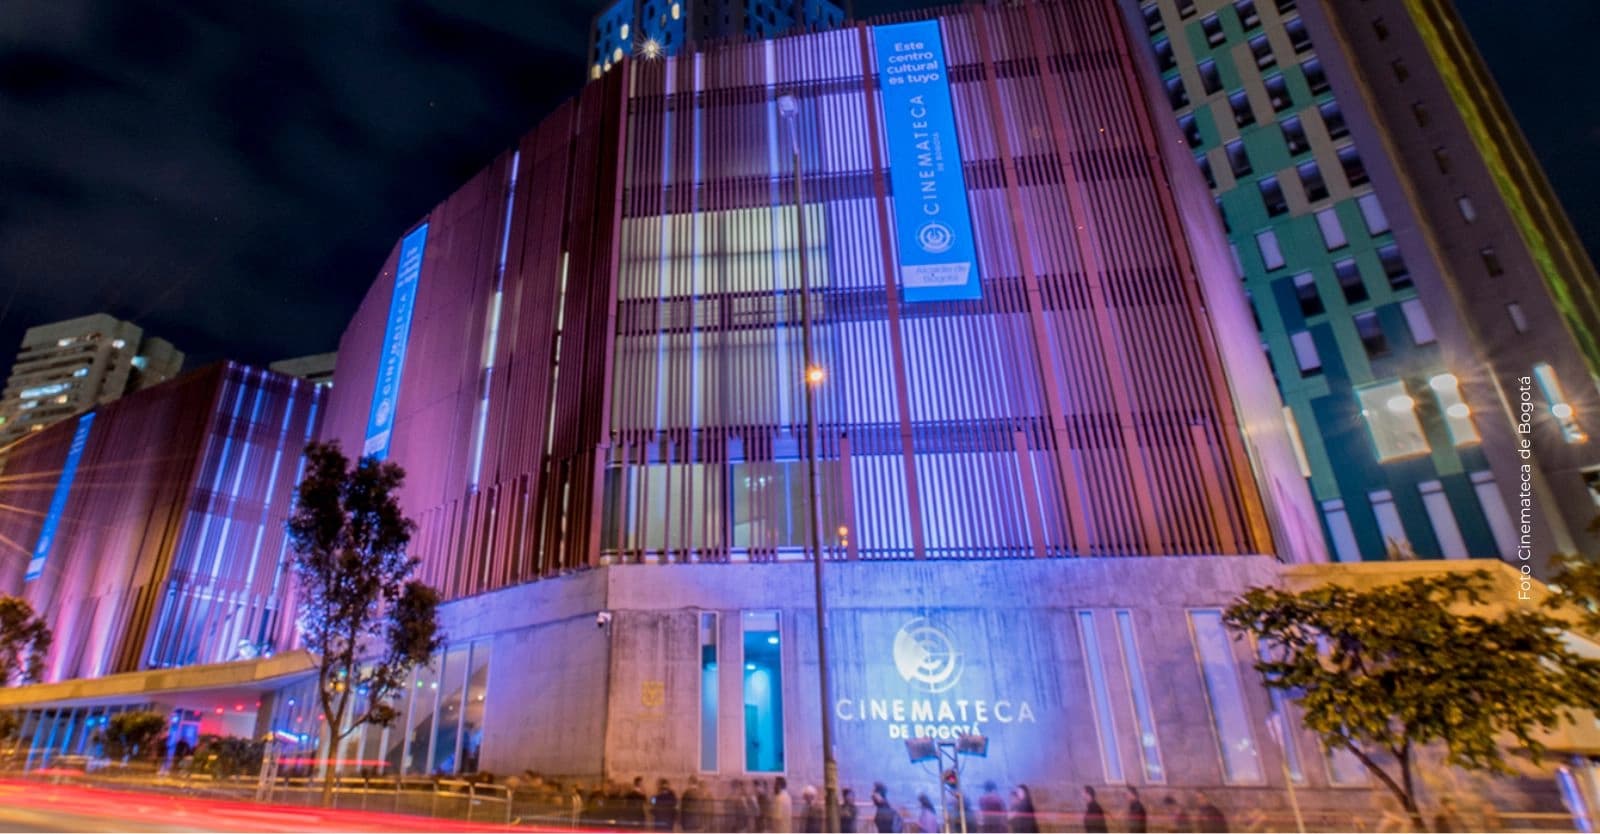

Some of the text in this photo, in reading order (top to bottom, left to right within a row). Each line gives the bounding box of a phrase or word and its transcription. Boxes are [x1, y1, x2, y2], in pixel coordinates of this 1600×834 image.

[894, 42, 924, 52] Este
[888, 51, 934, 63] centro
[887, 60, 939, 74] cultural
[888, 73, 940, 85] es tuyo
[910, 95, 940, 215] CINEMATECA
[835, 698, 1036, 723] CINEMATECA
[889, 722, 981, 739] DE BOGOTÁ
